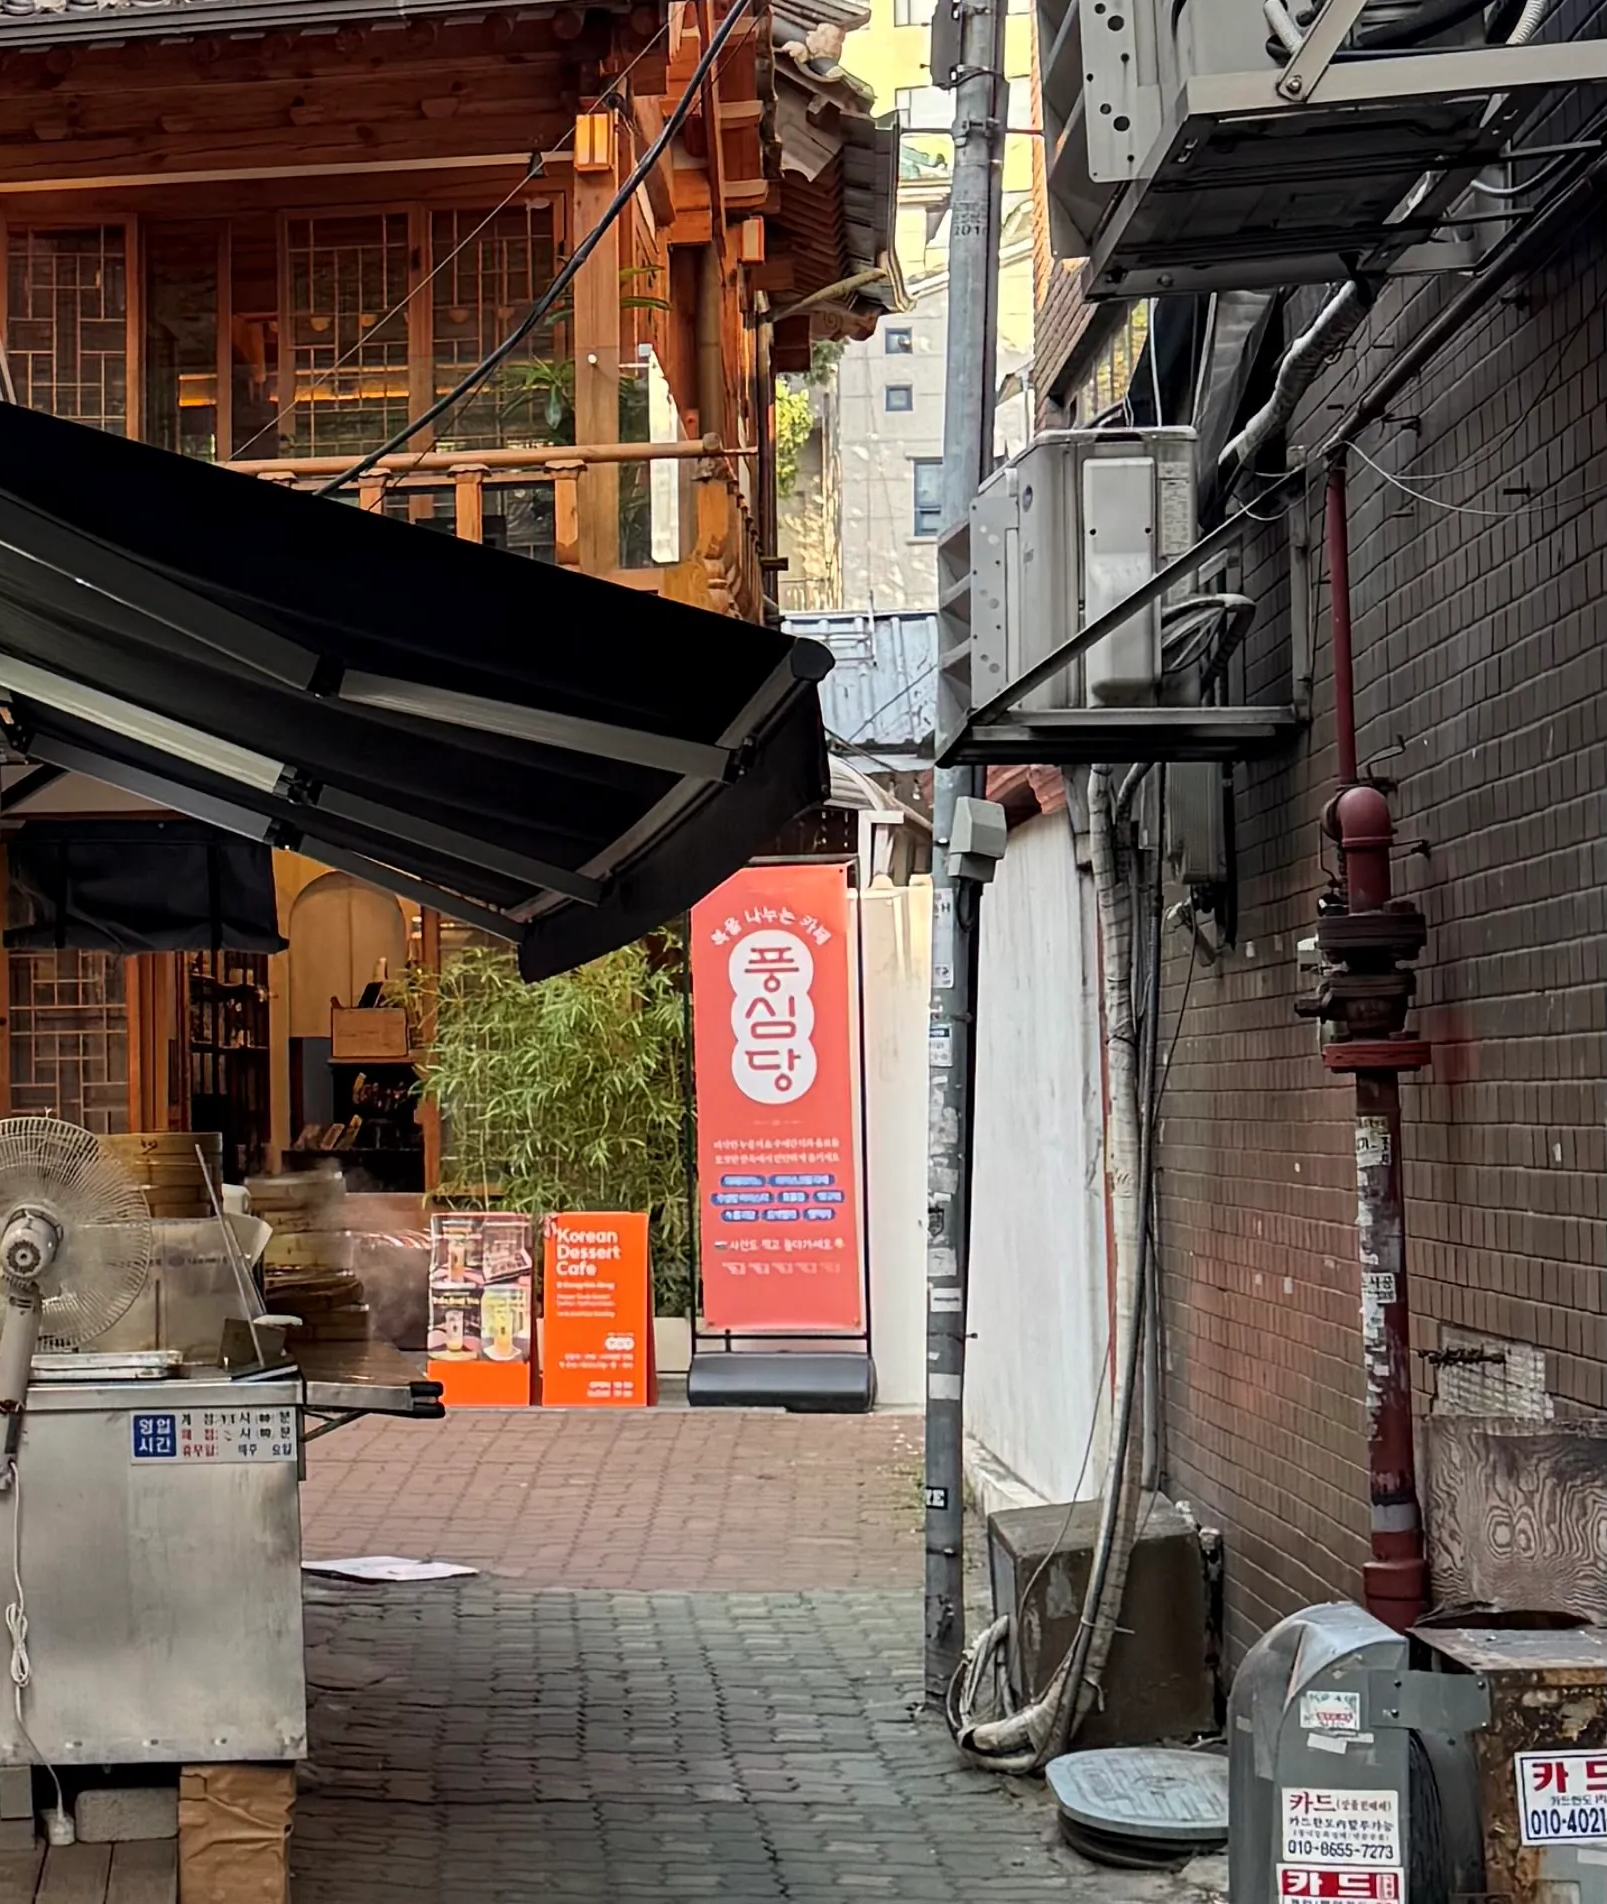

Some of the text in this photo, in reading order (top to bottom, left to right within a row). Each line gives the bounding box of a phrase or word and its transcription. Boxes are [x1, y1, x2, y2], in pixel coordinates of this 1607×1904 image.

[744, 905, 796, 925] 나누는
[799, 915, 832, 945] 카페
[744, 947, 801, 1092] 풍심당
[557, 1228, 618, 1244] Korean
[556, 1245, 620, 1260] Dessert
[556, 1260, 597, 1276] Cafe
[139, 1418, 171, 1435] 영업
[139, 1437, 171, 1454] 시간
[1532, 1760, 1607, 1793] 카드
[1289, 1791, 1336, 1815] 카드
[1287, 1871, 1372, 1896] 카드
